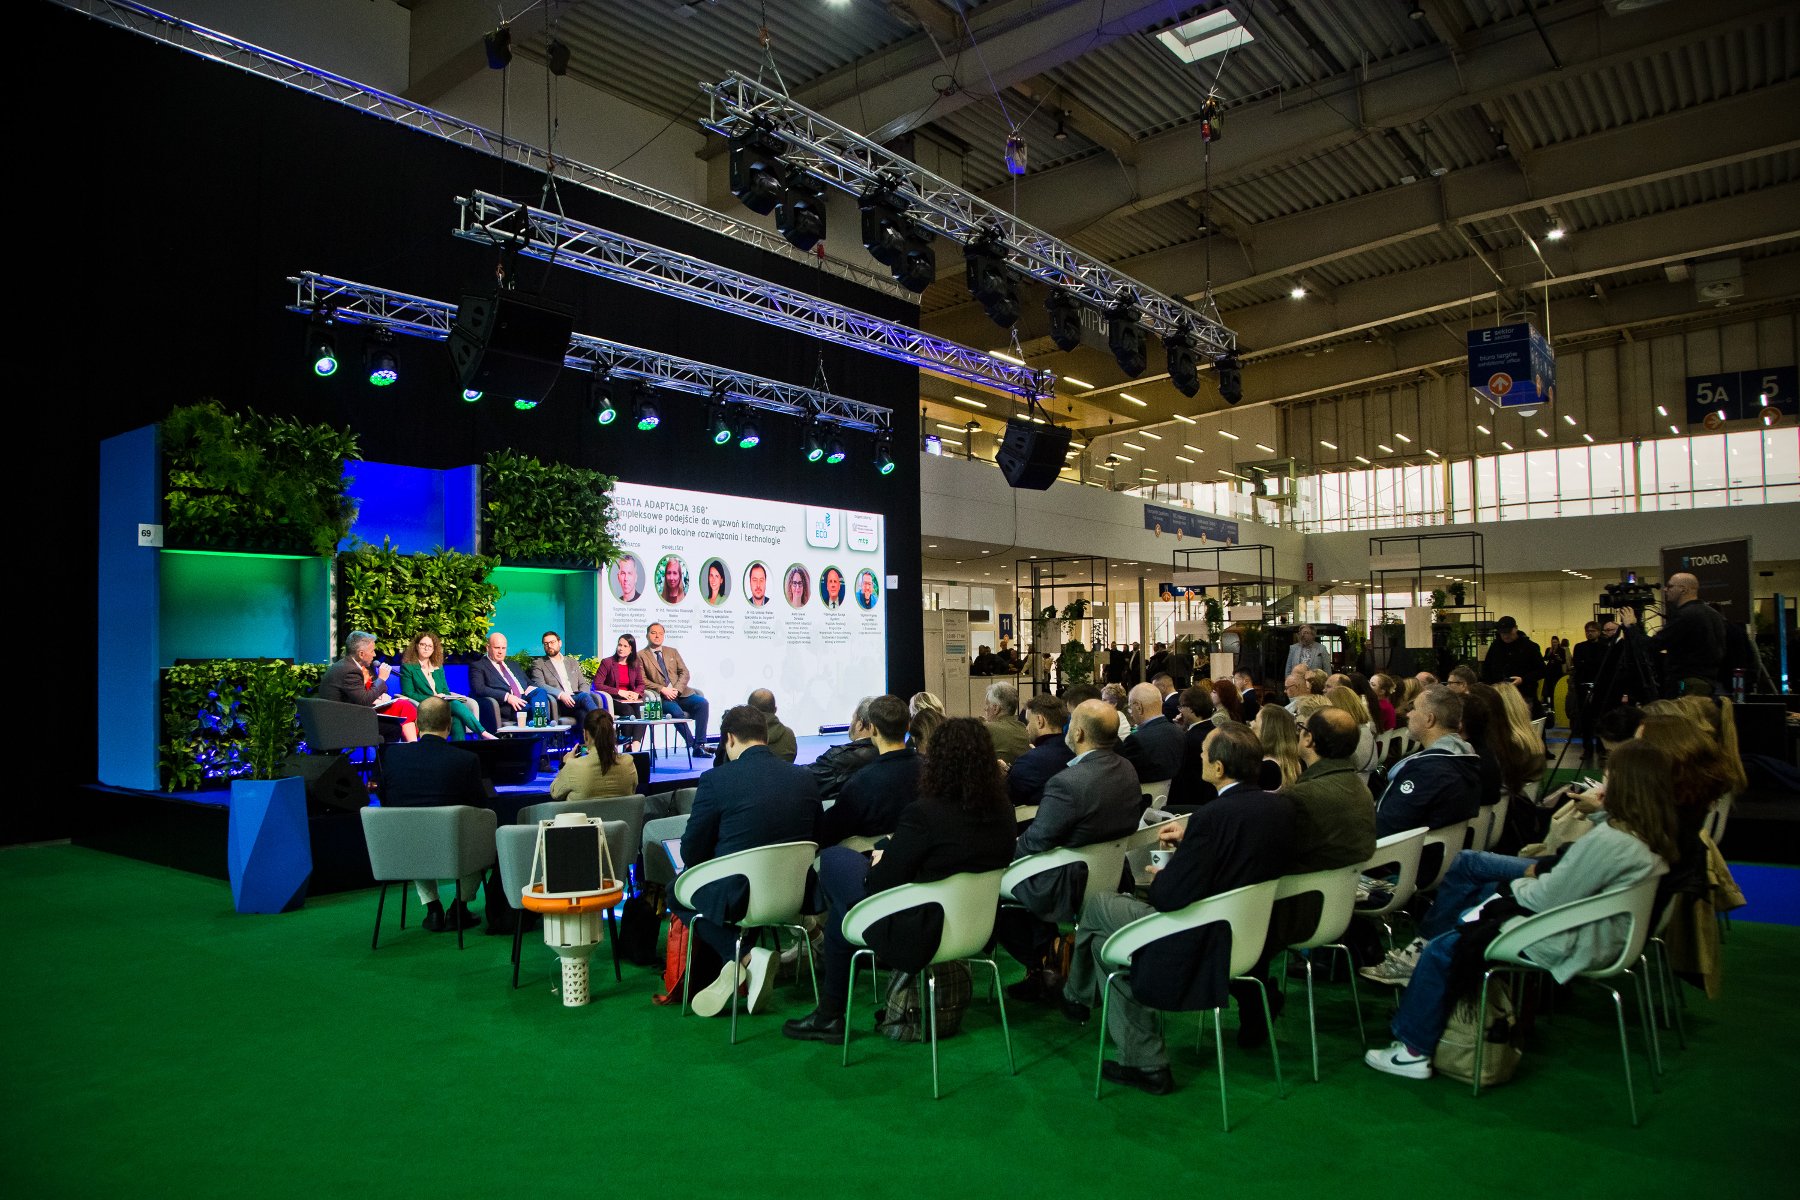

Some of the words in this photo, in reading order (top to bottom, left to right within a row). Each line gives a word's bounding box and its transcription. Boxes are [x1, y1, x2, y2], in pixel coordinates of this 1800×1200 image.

[1483, 331, 1492, 342] E
[1696, 382, 1729, 405] 5A
[1761, 375, 1780, 398] 5
[645, 500, 689, 512] ADAPTACJA
[618, 510, 662, 520] mpleksowe
[665, 514, 698, 524] podejście
[701, 517, 710, 525] do
[712, 519, 739, 529] wyzwań
[741, 521, 786, 533] klimatycznych
[141, 529, 152, 538] 69
[629, 523, 657, 535] polityki
[659, 527, 669, 536] po
[670, 527, 696, 538] lokalne
[698, 531, 738, 541] rozwiązania
[745, 533, 781, 545] technologie
[1690, 553, 1729, 568] TOMRA
[1002, 617, 1011, 632] 11
